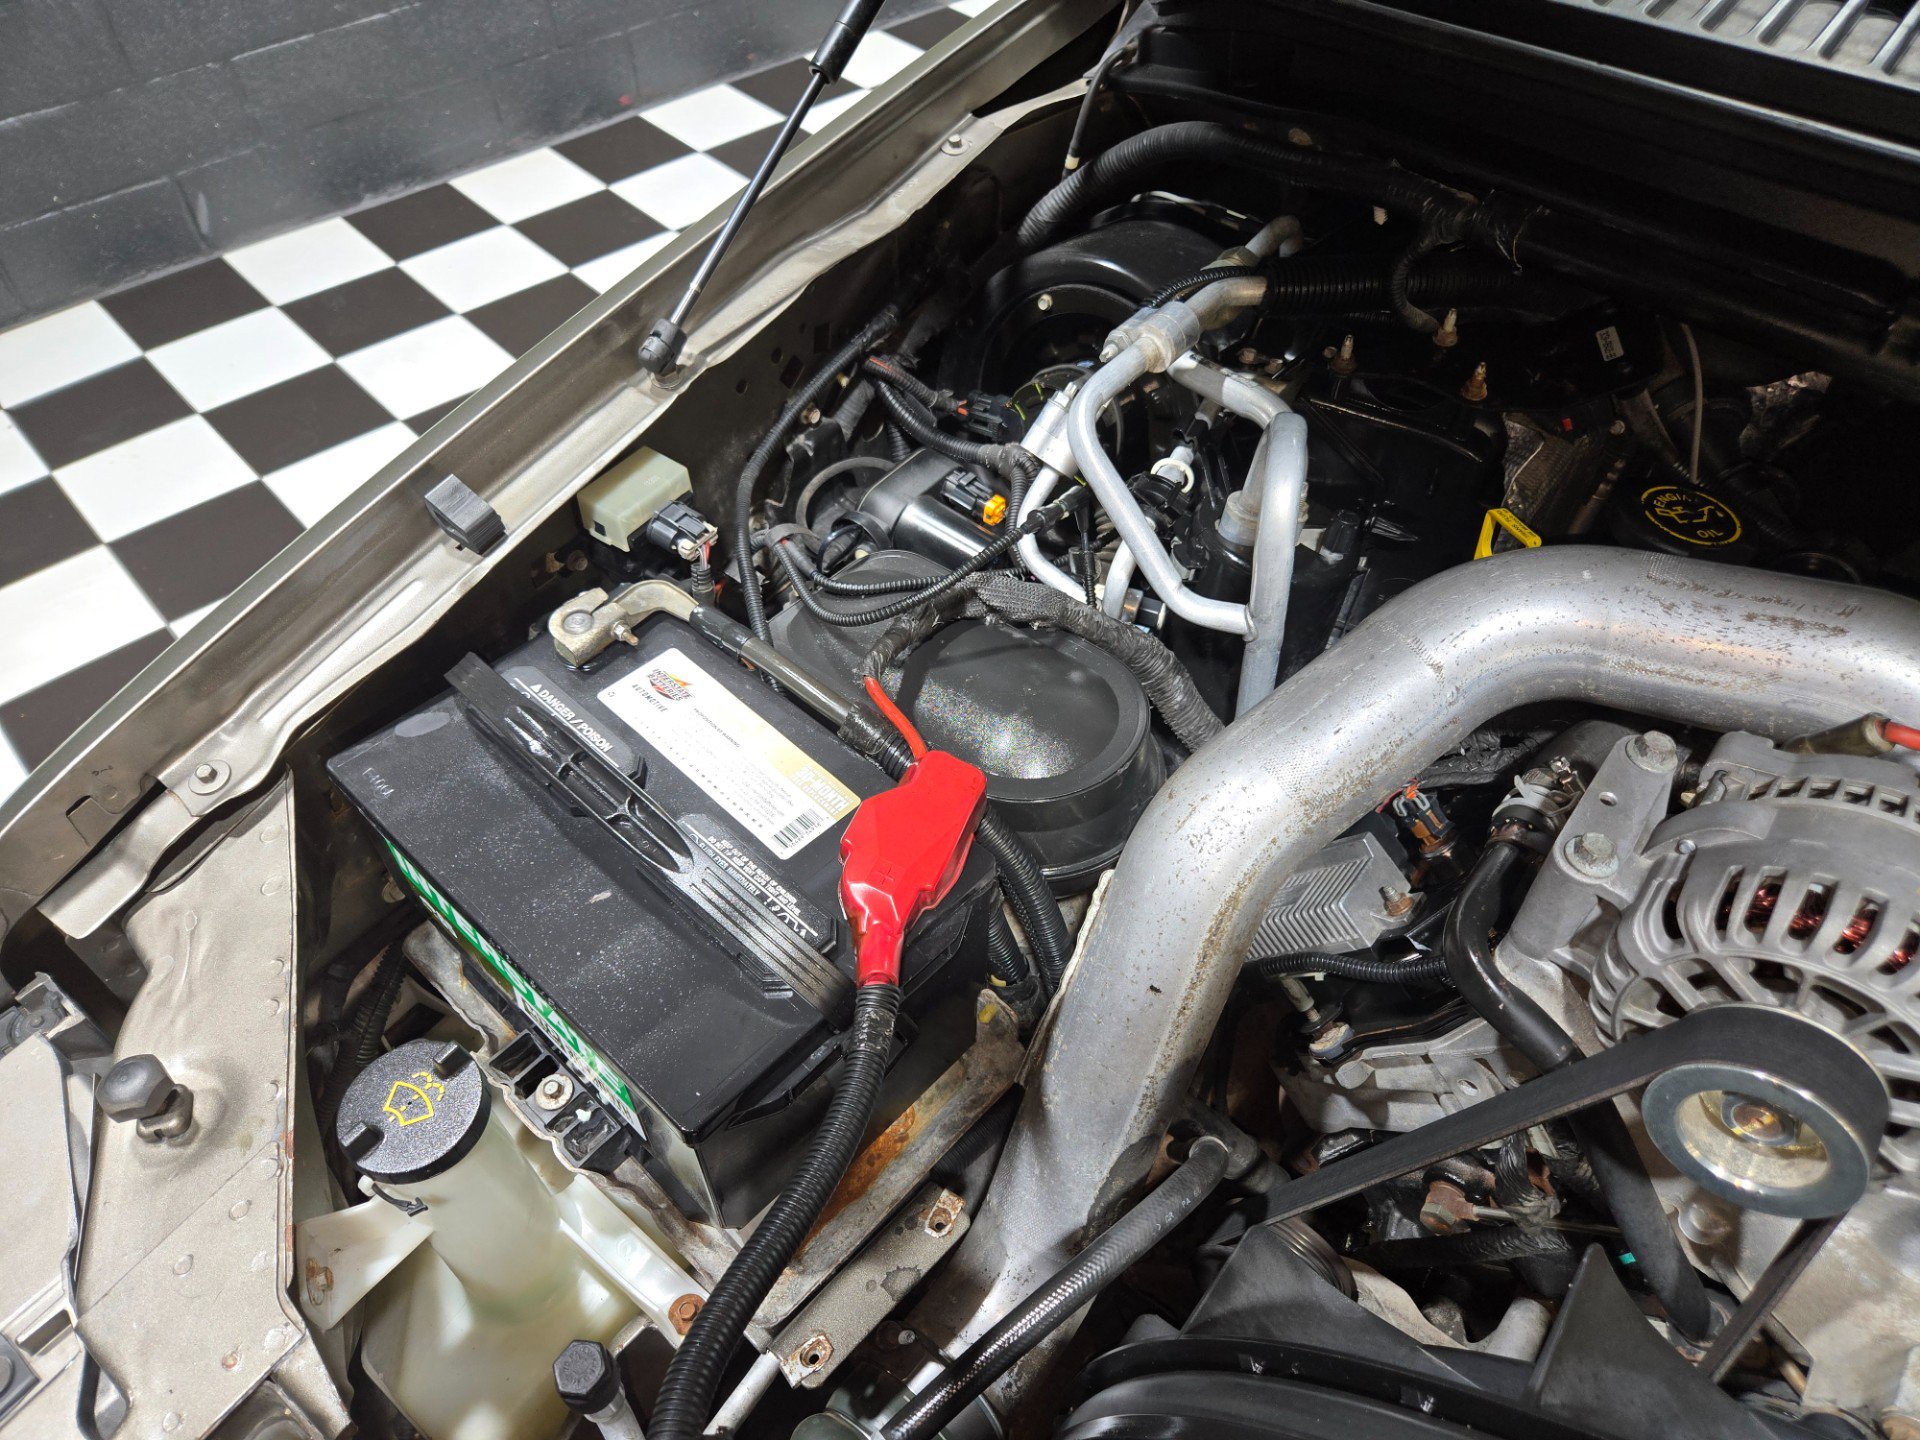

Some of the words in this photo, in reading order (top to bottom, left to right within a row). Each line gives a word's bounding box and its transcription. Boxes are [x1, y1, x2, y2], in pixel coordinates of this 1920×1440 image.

[1696, 529, 1724, 539] OIL
[632, 683, 669, 713] AUTOMOTIVE
[646, 673, 684, 702] BATTERIES
[652, 668, 693, 700] INTERSTATE
[714, 855, 729, 869] EYES
[725, 866, 761, 896] IMMEDIATELY
[747, 860, 758, 870] THE
[391, 846, 623, 1094] INTERSTATE
